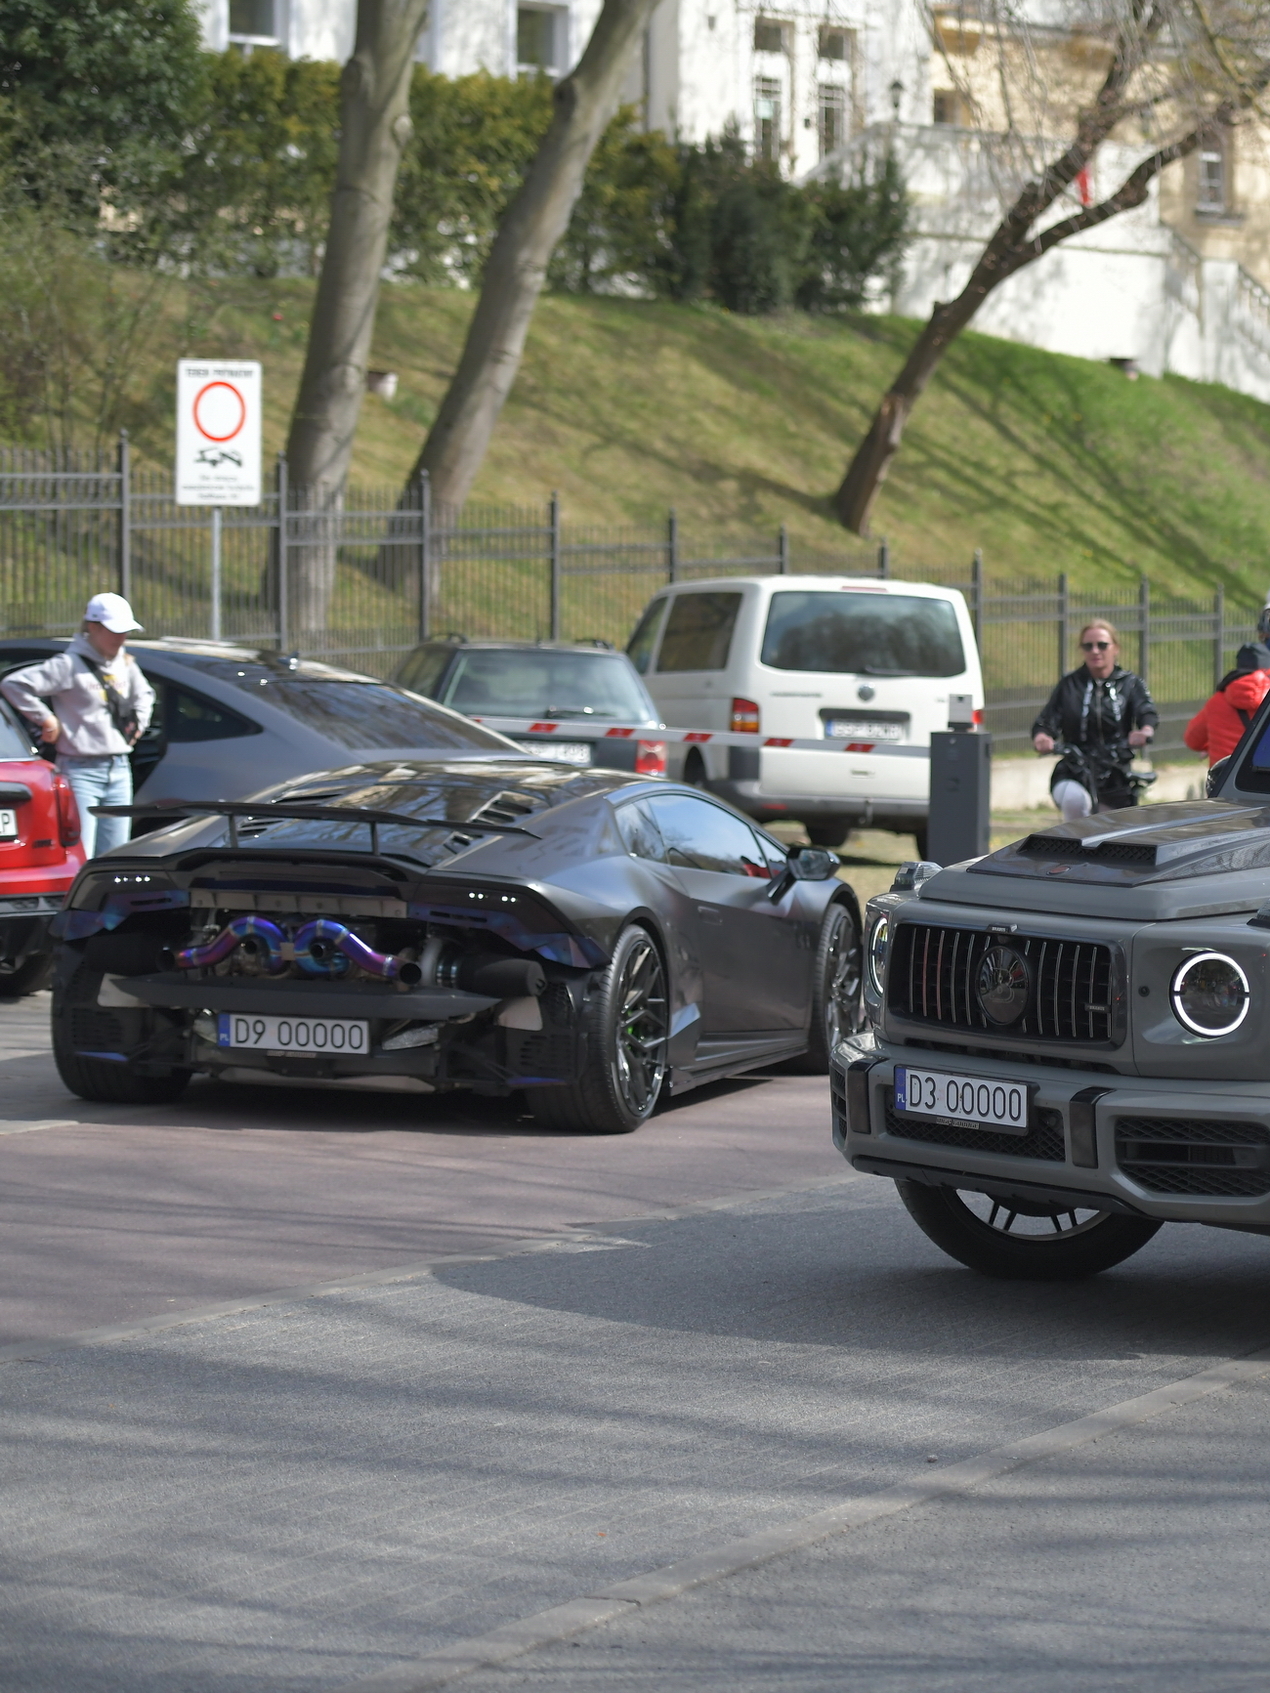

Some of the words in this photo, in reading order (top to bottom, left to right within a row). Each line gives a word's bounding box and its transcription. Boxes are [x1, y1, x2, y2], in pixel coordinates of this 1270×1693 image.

[219, 1033, 230, 1042] PL
[234, 1017, 267, 1045] D9
[277, 1020, 364, 1051] 00000
[897, 1092, 905, 1103] PL
[909, 1073, 937, 1110] D3
[946, 1079, 1022, 1123] 00000
